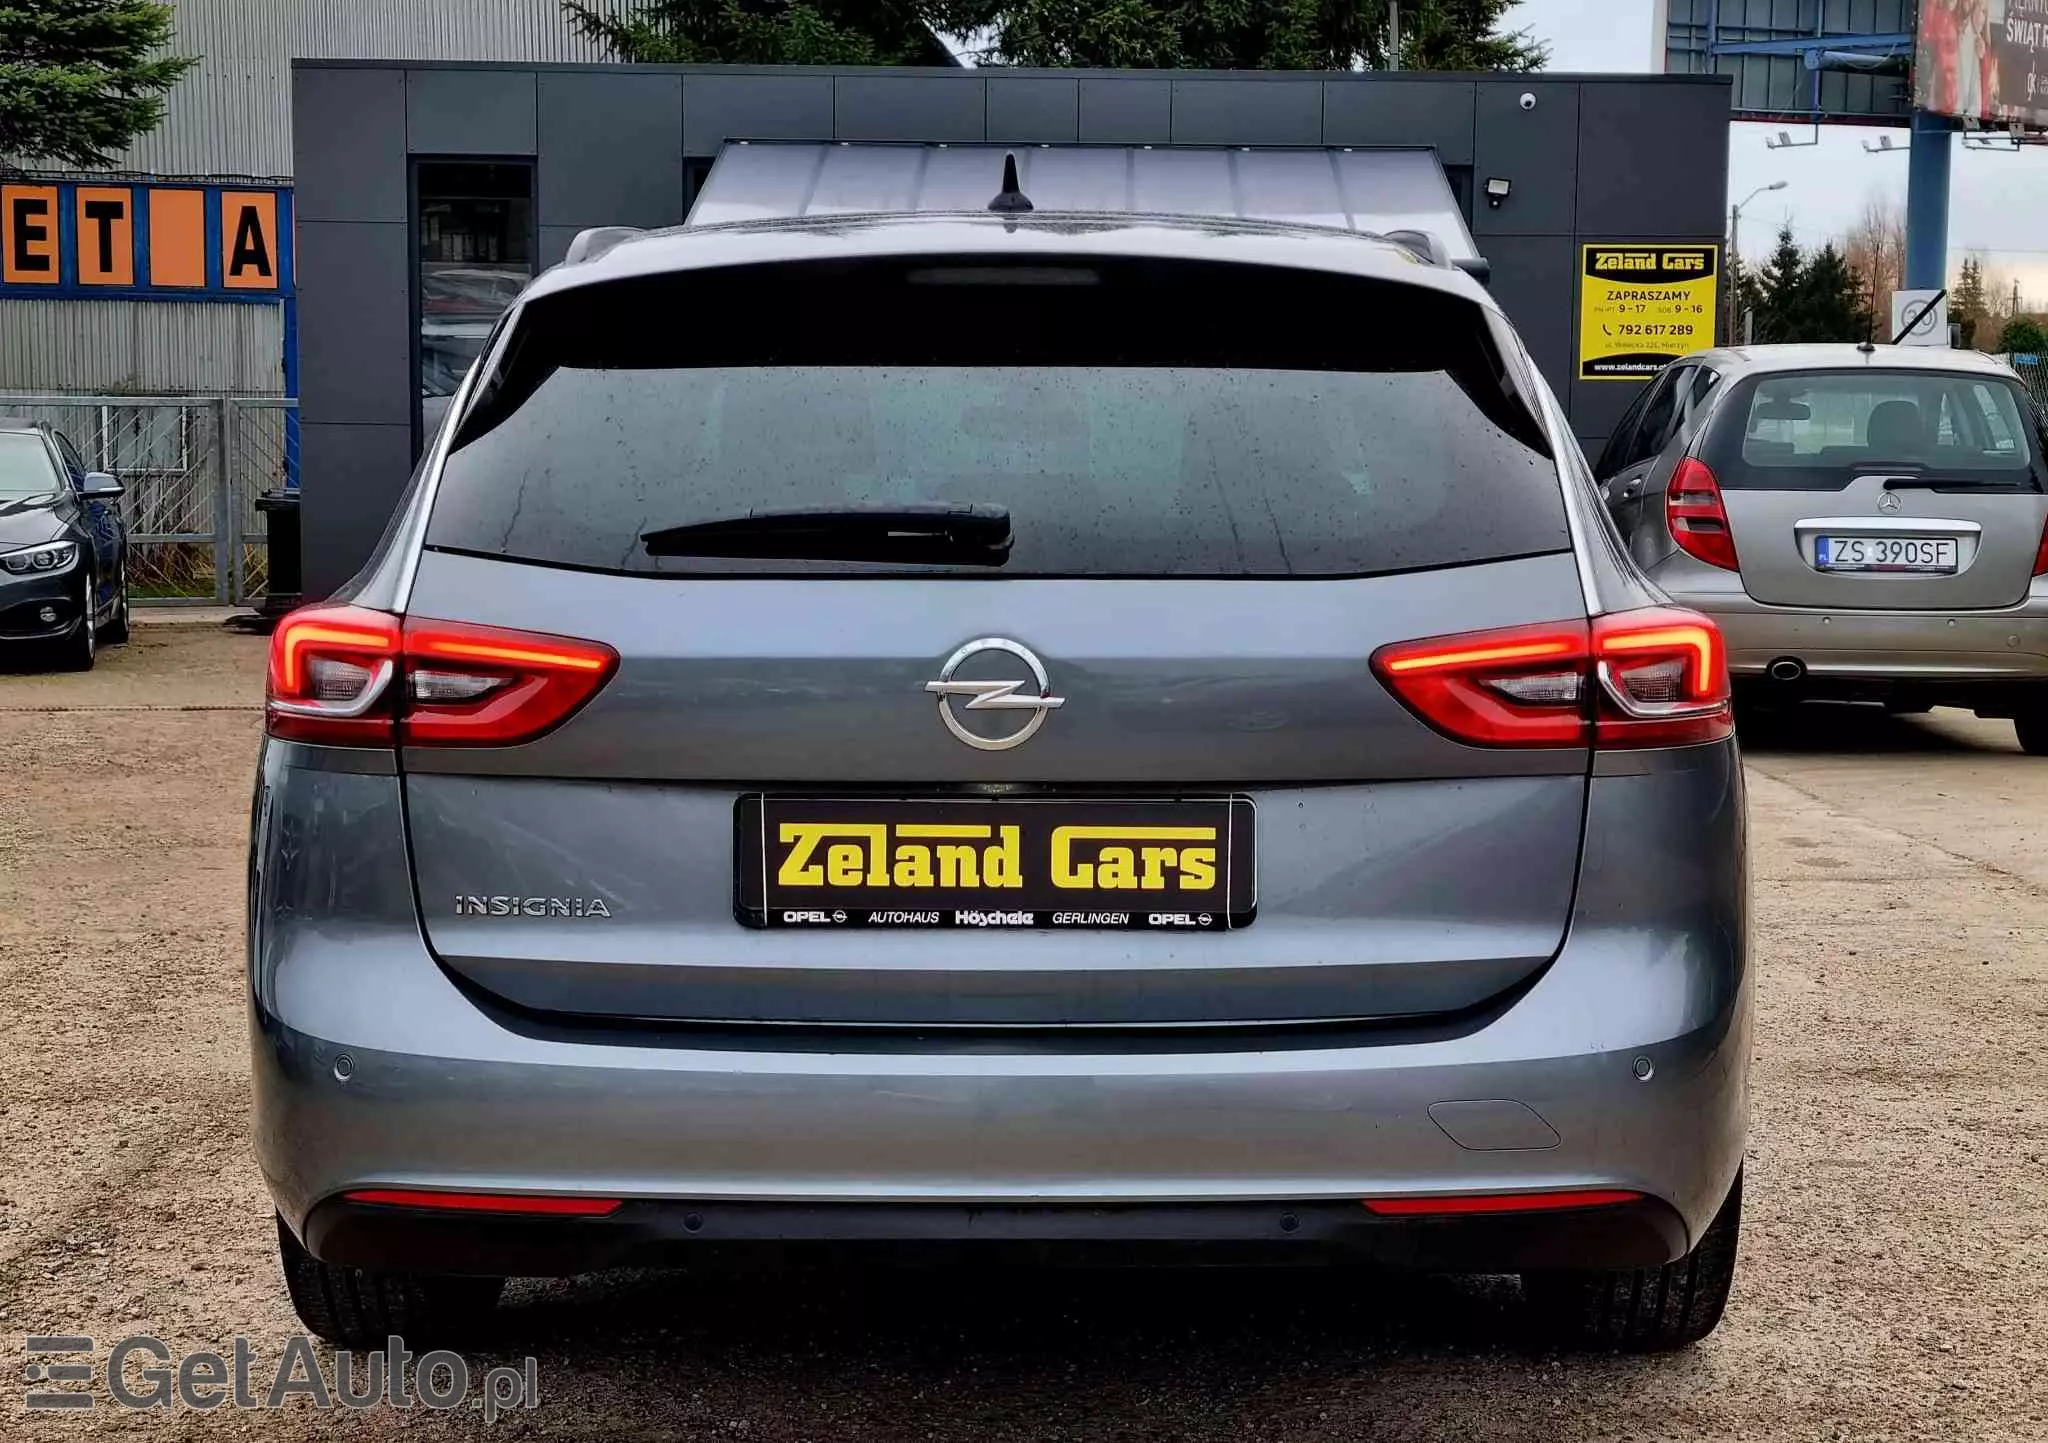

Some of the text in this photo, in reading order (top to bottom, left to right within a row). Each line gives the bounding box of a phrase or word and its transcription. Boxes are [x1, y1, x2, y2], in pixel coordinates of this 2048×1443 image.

[1595, 253, 1705, 271] Zeland Cars
[1607, 290, 1691, 301] ZAPRASZAMY
[1619, 324, 1694, 335] 792 617 289
[1834, 541, 1950, 565] ZS 390SF
[778, 823, 1217, 890] Zeland Cars
[455, 895, 612, 918] INSIGNIA
[783, 911, 831, 923] OPEL
[868, 911, 940, 924] AUTOHAUS
[1052, 912, 1130, 924] GERLINGEN
[1148, 913, 1197, 925] OPEL
